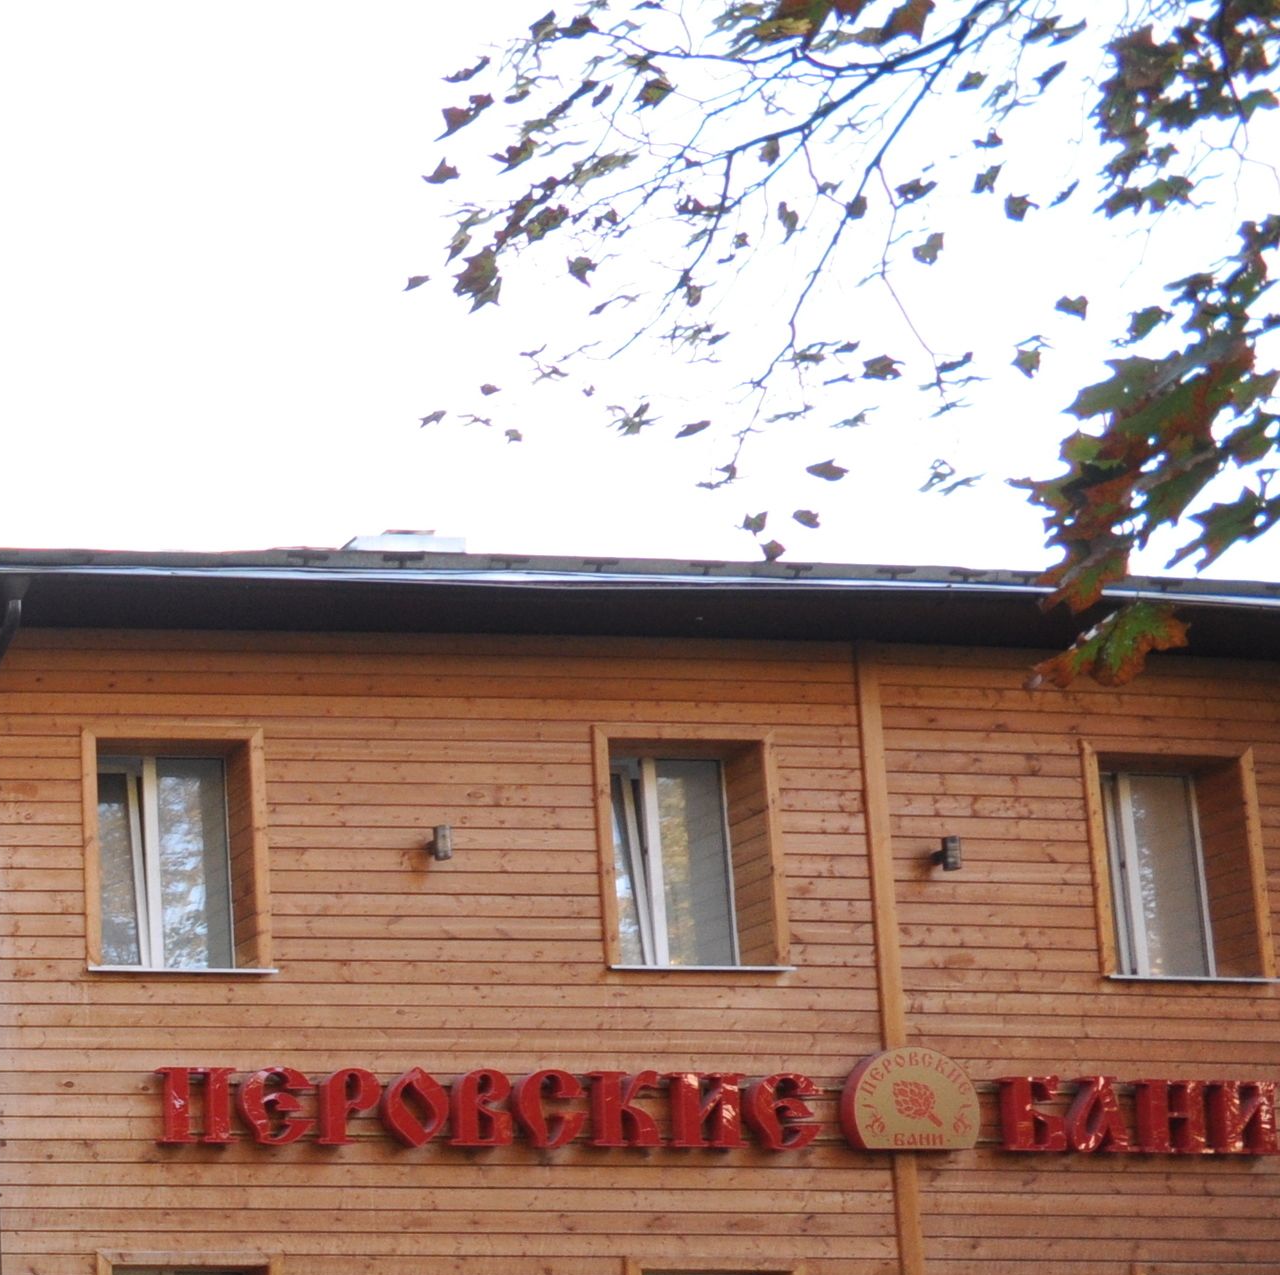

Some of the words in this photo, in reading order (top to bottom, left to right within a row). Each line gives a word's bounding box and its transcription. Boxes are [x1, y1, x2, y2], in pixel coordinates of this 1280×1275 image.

[860, 1051, 971, 1096] ПЕРОВСКИЕ
[154, 1065, 824, 1151] ПЕРОВСКИЕ
[992, 1074, 1279, 1156] БАНИ
[893, 1132, 944, 1147] БАНИ
